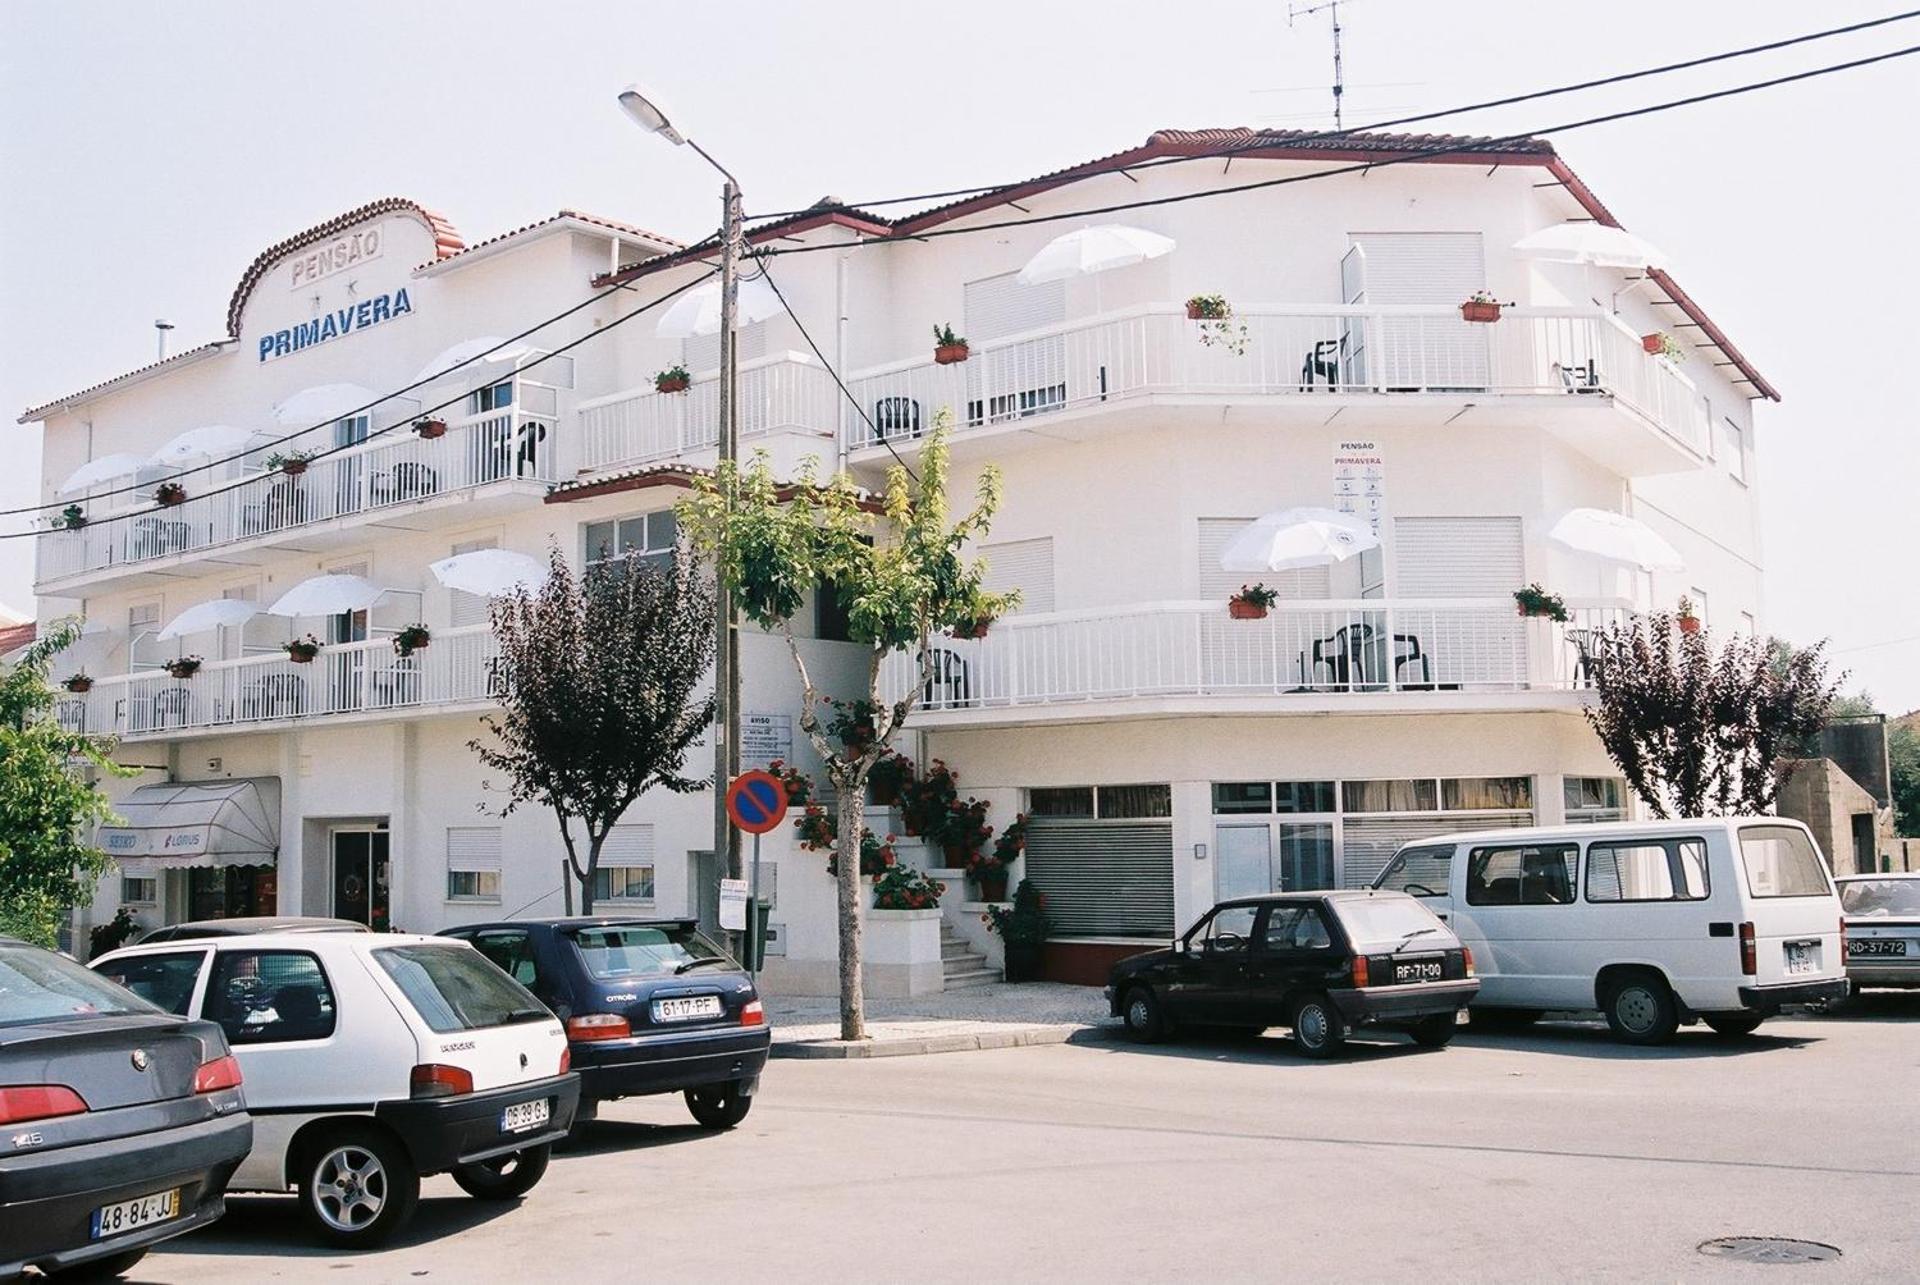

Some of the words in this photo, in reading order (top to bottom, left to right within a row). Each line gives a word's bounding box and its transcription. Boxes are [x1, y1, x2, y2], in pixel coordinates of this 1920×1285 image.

[259, 287, 412, 362] PRIMAVERA
[171, 833, 200, 847] LORUS
[1849, 941, 1905, 953] RD-37-72
[1396, 963, 1441, 979] RF-71-00
